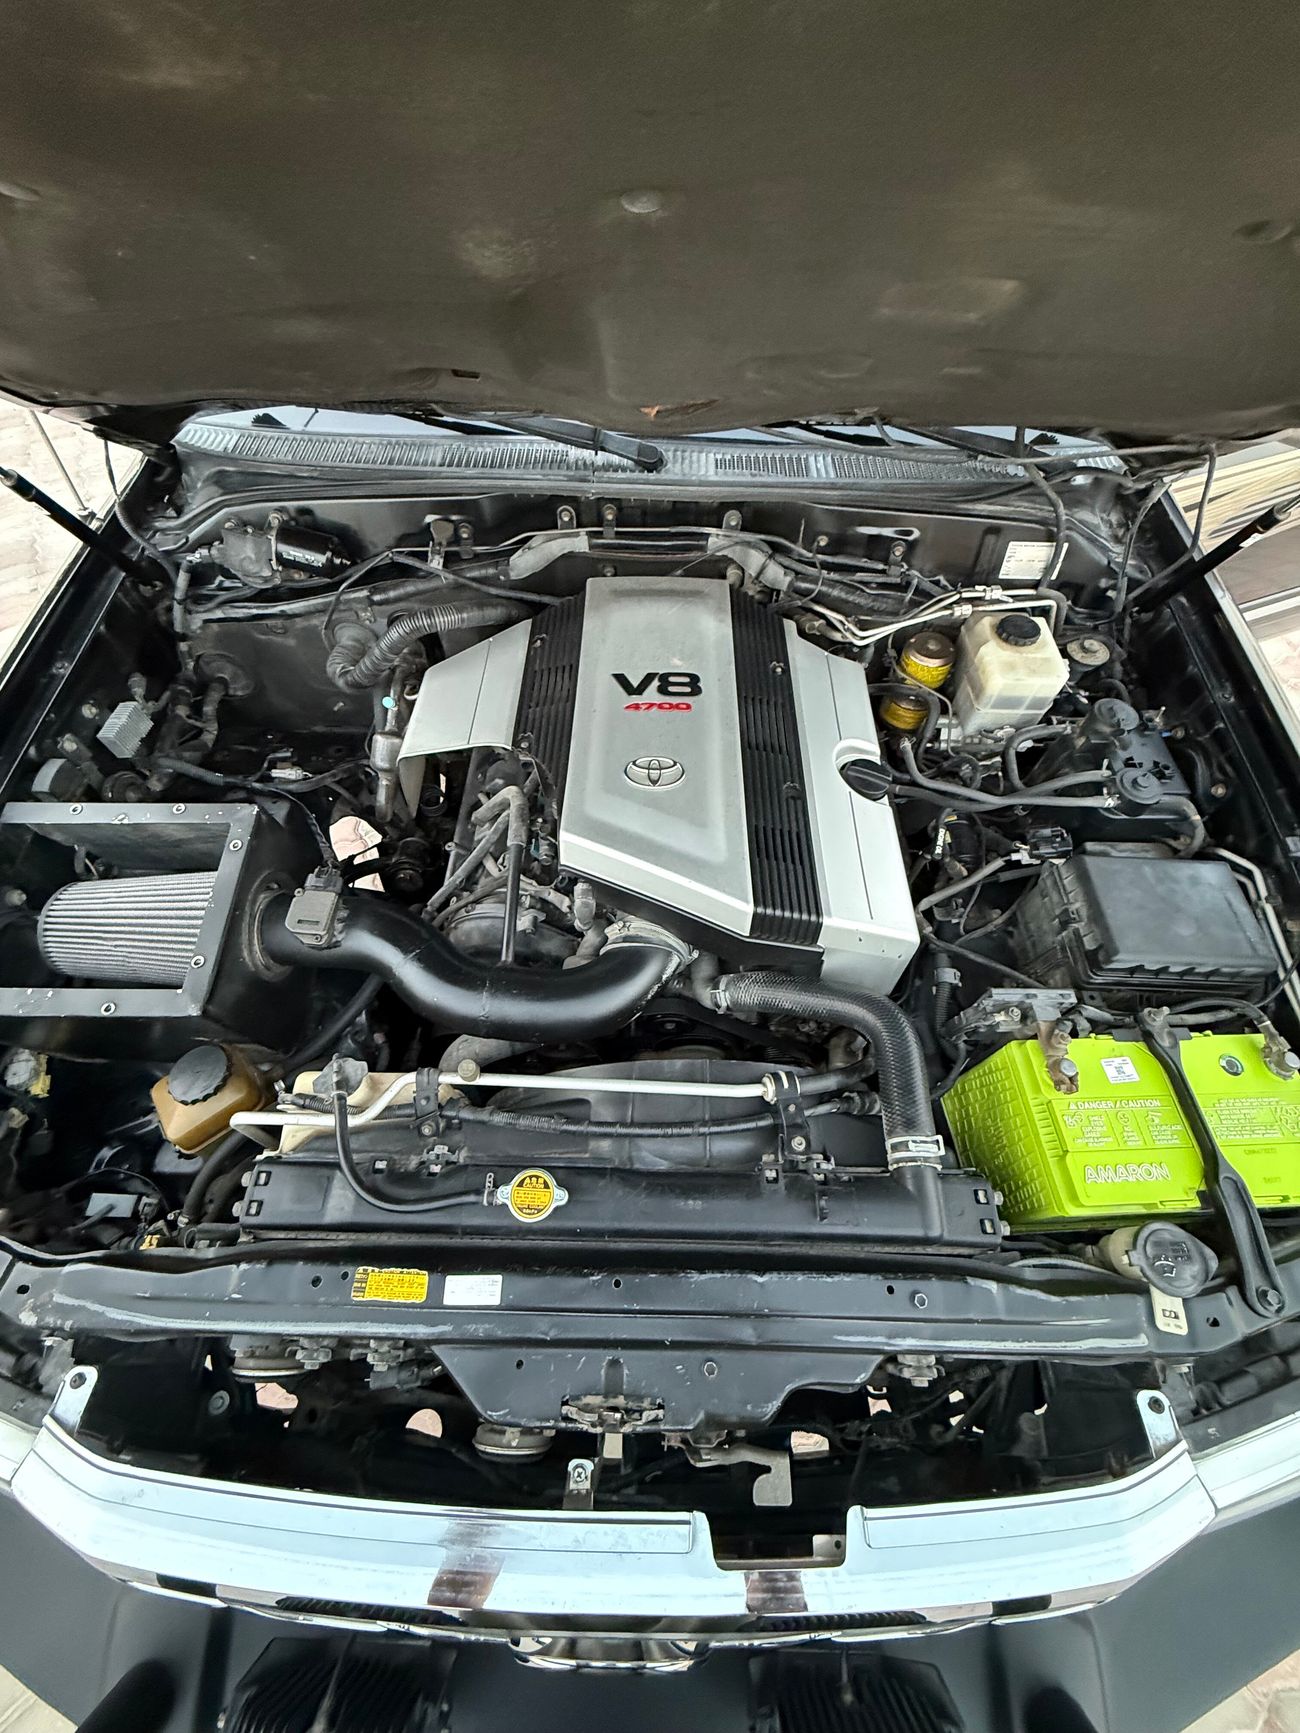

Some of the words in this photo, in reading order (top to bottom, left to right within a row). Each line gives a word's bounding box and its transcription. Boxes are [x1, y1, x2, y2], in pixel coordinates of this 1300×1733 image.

[611, 672, 703, 697] V8
[624, 702, 692, 713] 4700
[1077, 1100, 1114, 1109] DANGER
[1121, 1099, 1161, 1108] CAUTION
[1084, 1162, 1171, 1184] AMARON
